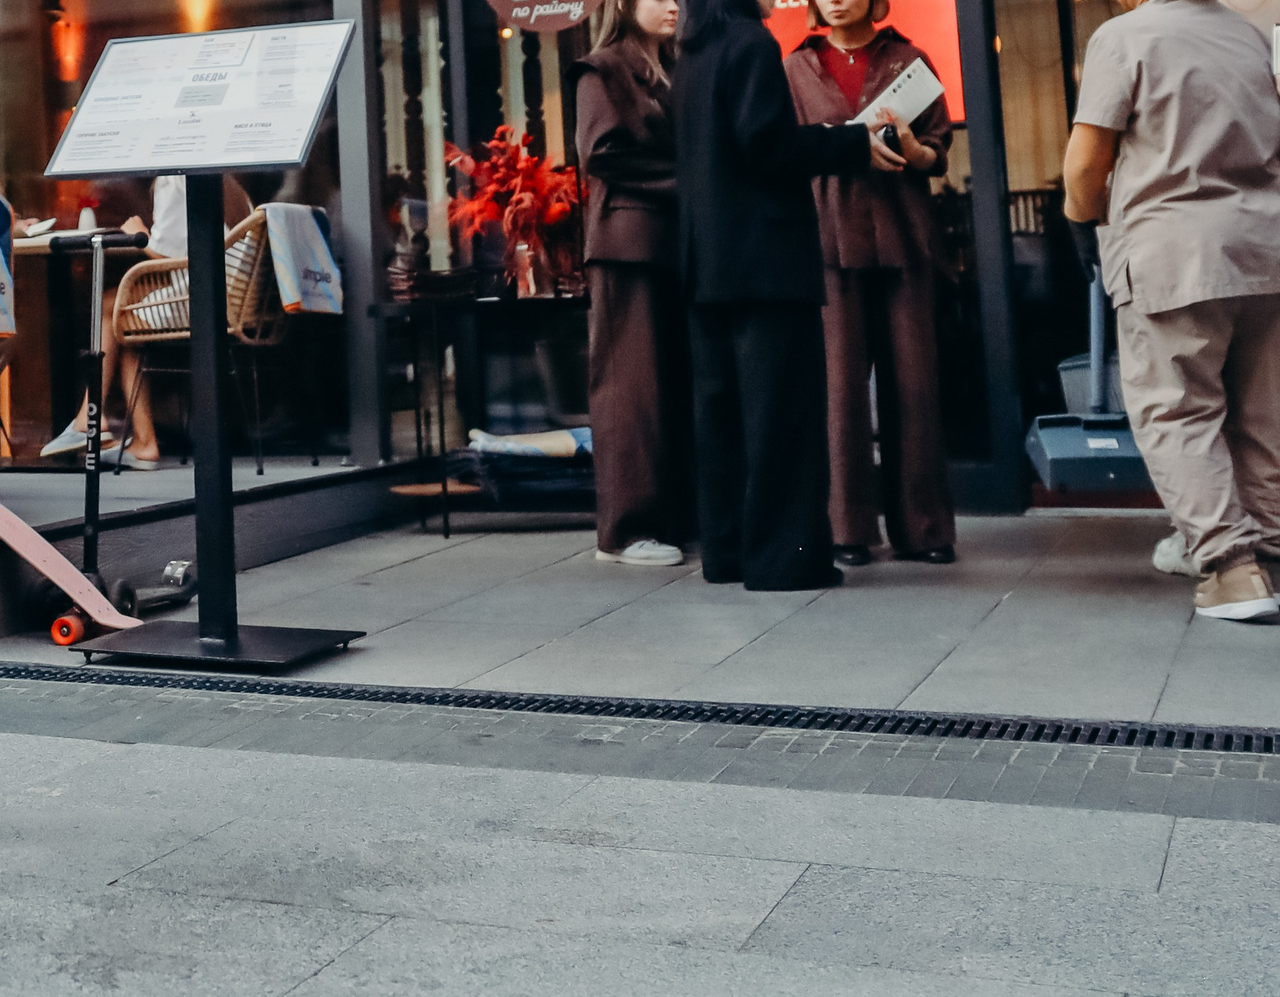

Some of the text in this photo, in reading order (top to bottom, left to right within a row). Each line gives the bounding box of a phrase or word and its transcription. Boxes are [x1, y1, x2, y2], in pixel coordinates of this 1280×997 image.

[512, 0, 584, 24] по району
[192, 72, 228, 82] ОБЕДЫ
